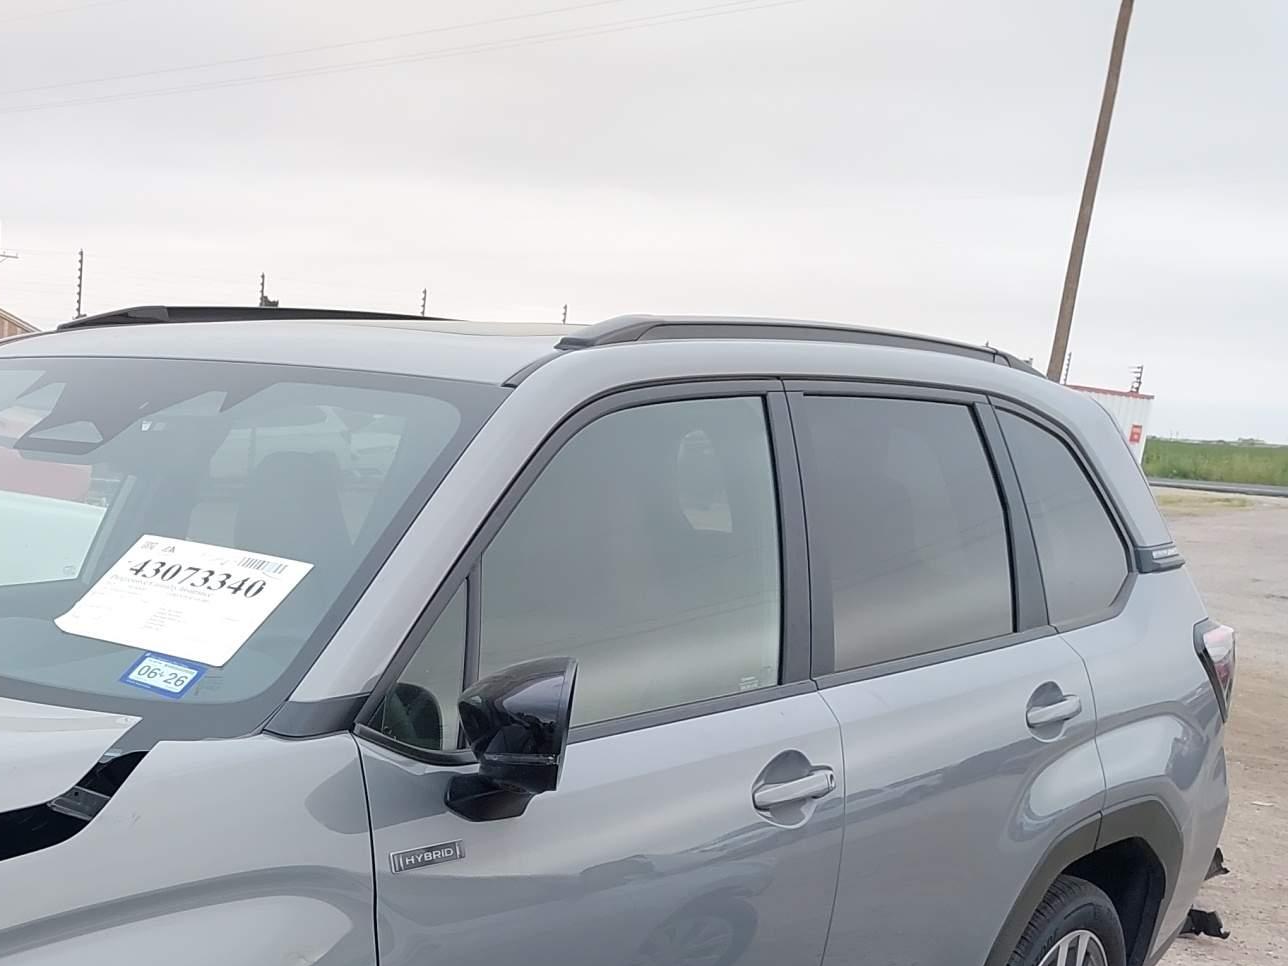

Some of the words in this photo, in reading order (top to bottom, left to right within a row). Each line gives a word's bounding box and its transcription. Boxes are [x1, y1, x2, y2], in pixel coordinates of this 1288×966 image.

[129, 558, 267, 599] 43073340
[137, 664, 161, 679] 06
[163, 672, 189, 687] 26
[405, 847, 454, 865] HYBRID
